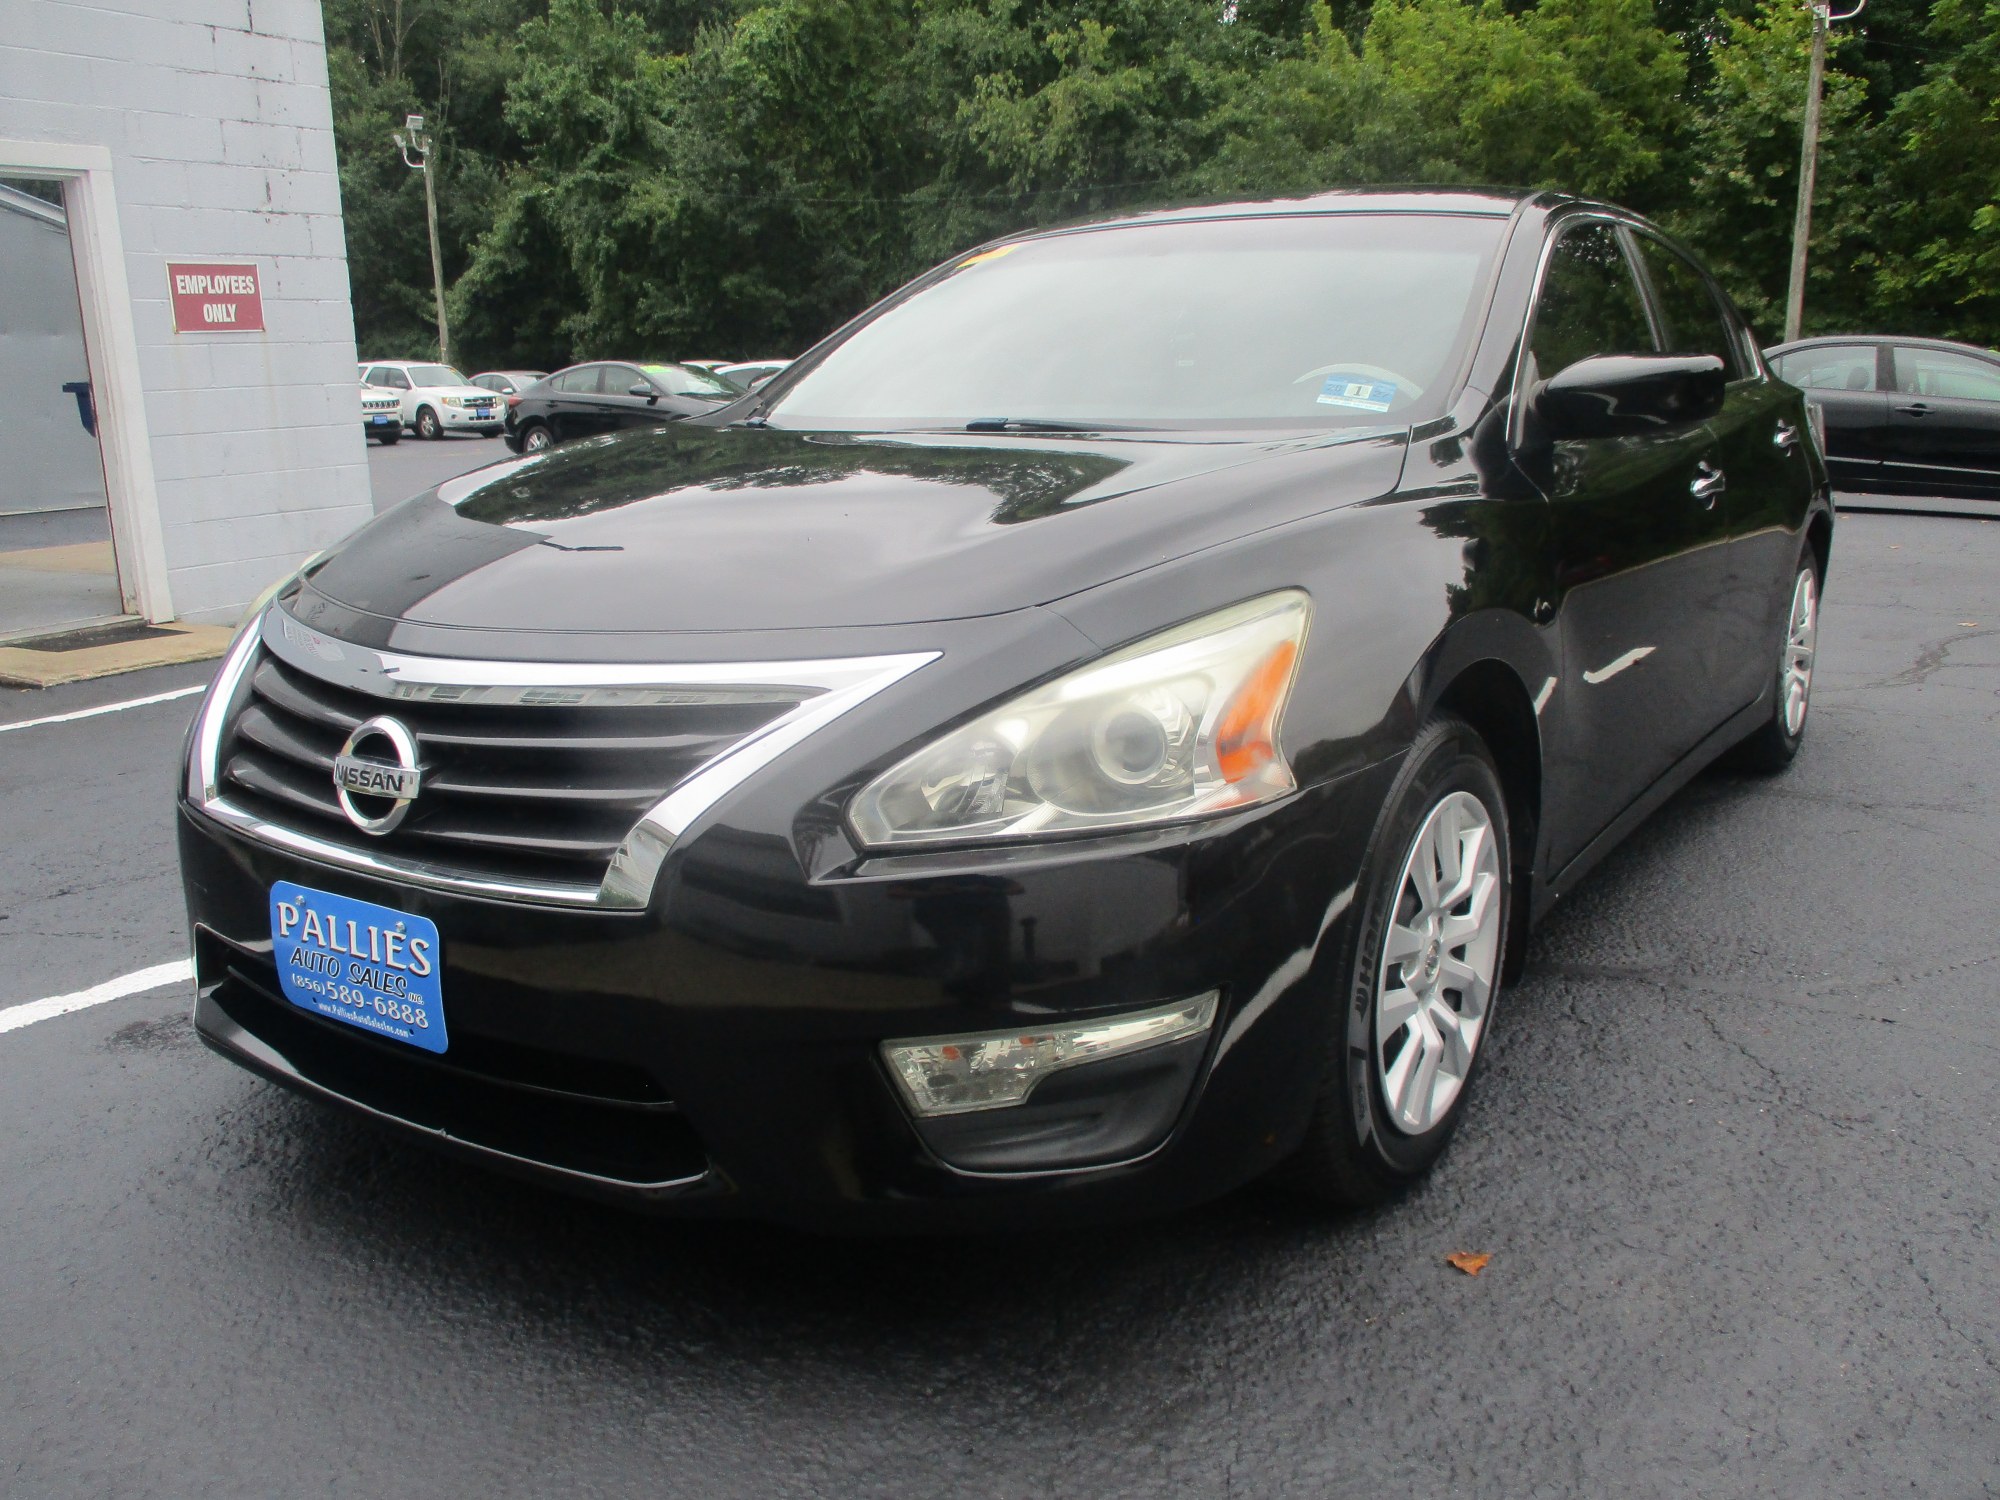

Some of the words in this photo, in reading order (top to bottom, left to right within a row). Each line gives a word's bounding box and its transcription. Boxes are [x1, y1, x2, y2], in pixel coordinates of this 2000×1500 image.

[175, 275, 255, 294] EMPLOYEES
[203, 303, 237, 323] ONLY
[334, 763, 405, 792] NISSAN
[277, 901, 432, 977] PALLIES
[290, 947, 342, 979] AUTO
[348, 962, 407, 999] SALES
